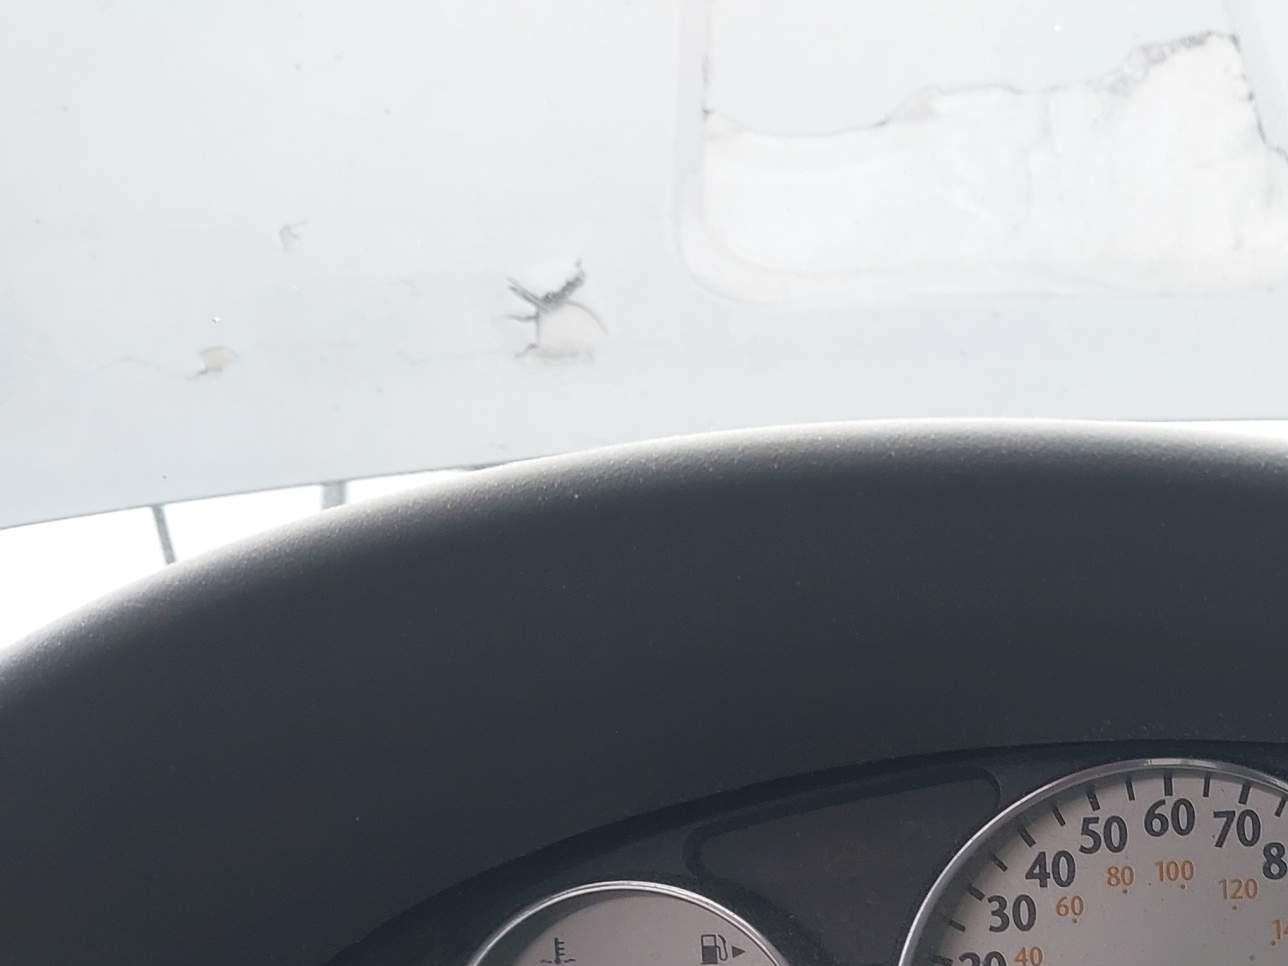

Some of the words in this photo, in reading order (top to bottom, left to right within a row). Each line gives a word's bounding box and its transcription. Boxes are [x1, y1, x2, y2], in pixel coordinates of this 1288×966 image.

[1144, 798, 1195, 837] 60
[1213, 809, 1261, 848] 70
[1079, 815, 1127, 854] 50
[1025, 850, 1076, 887] 40
[1106, 865, 1134, 887] 80
[1155, 860, 1194, 881] 100
[1218, 878, 1258, 900] 120
[987, 894, 1036, 932] 30
[1056, 895, 1084, 917] 60
[1014, 946, 1043, 966] 40
